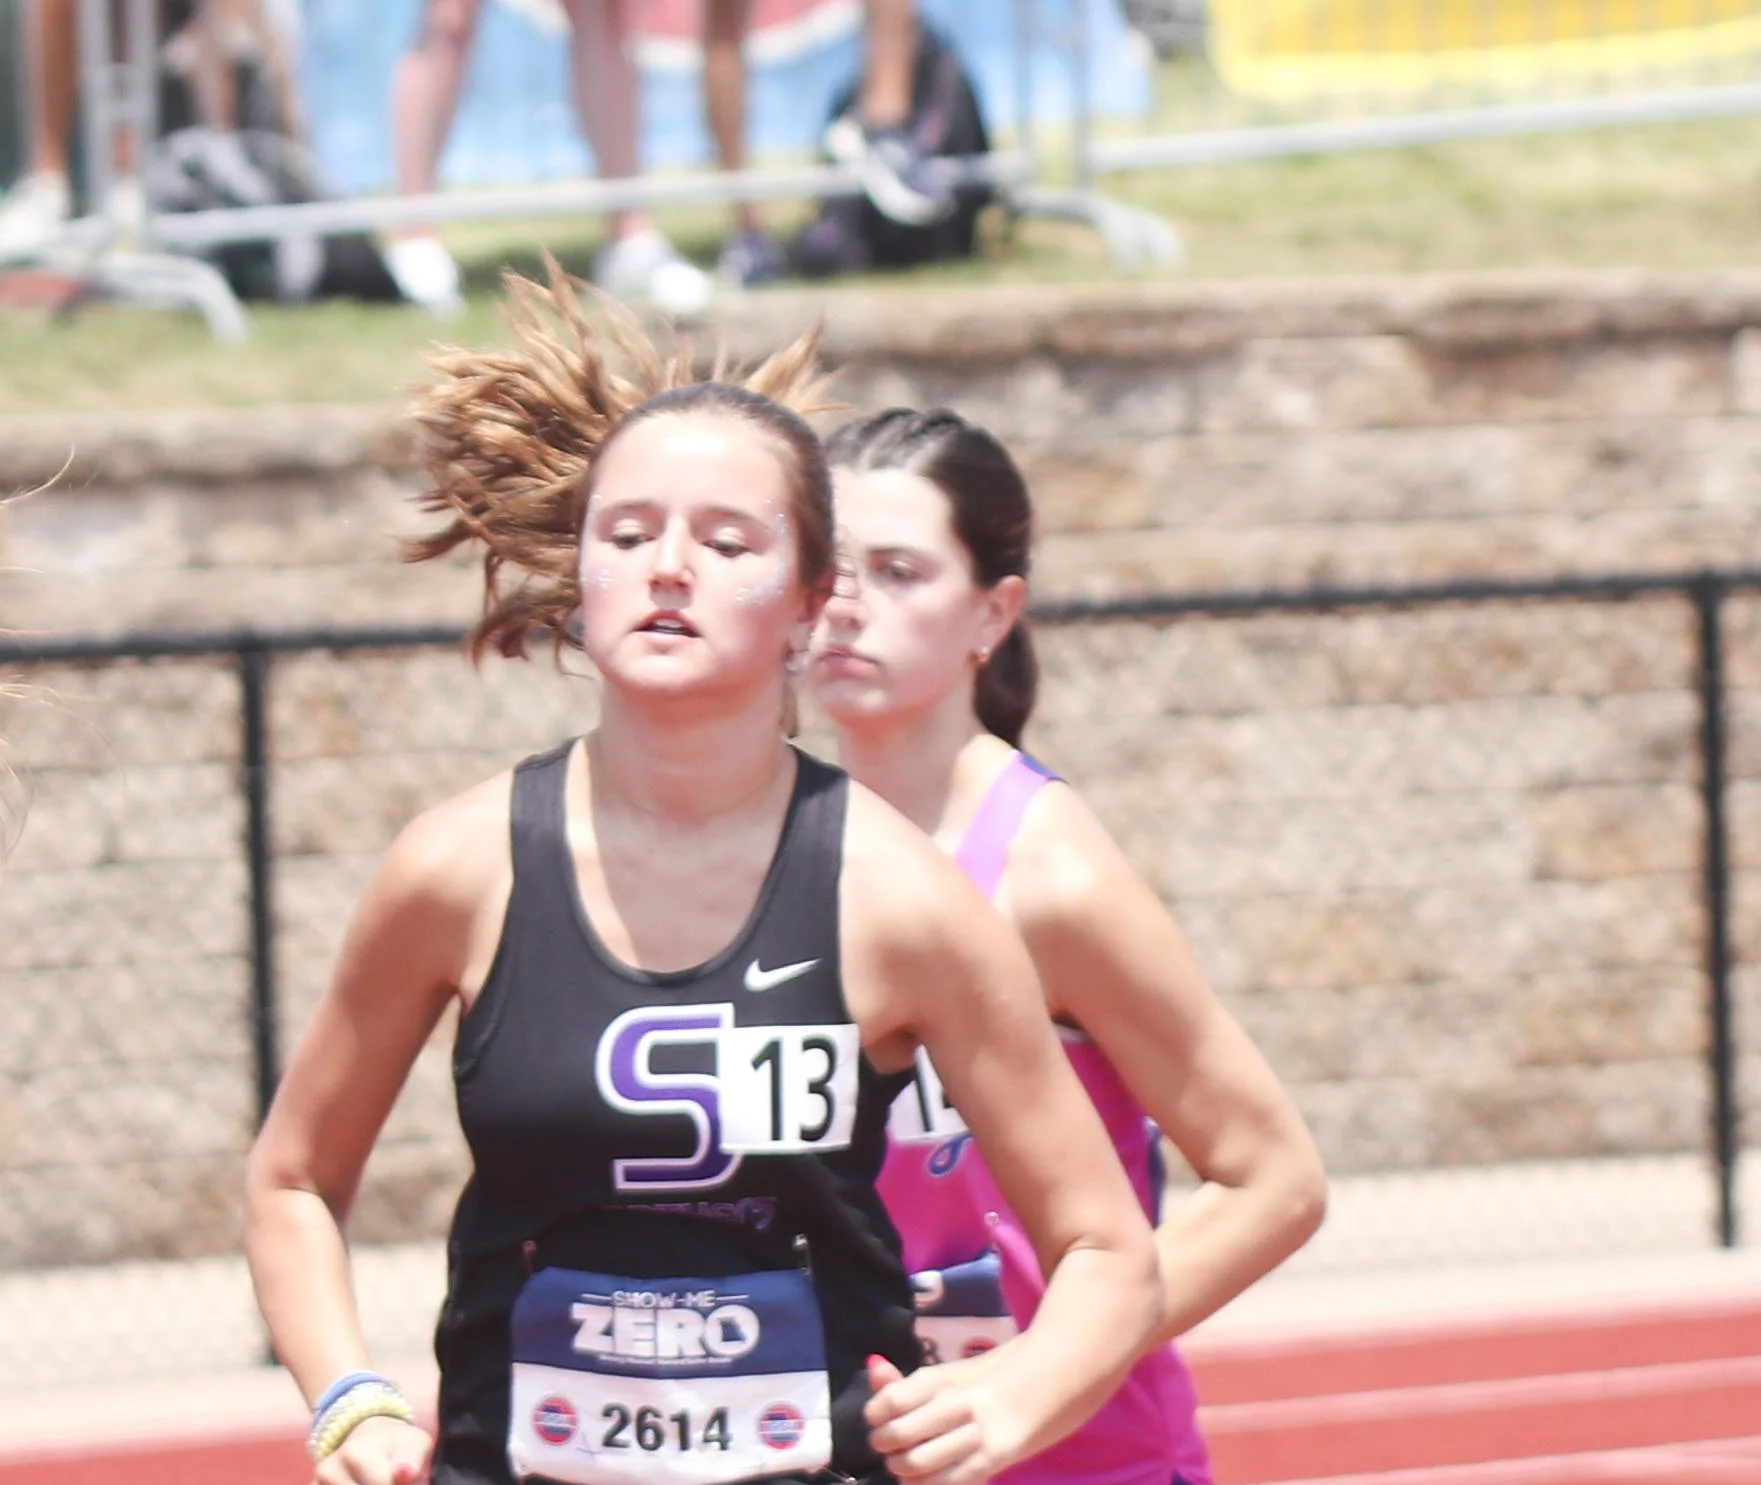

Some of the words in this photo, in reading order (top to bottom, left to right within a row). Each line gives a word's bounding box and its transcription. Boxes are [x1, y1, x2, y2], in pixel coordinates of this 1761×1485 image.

[594, 1002, 742, 1192] S
[750, 1034, 837, 1142] 13
[612, 1290, 717, 1308] SHOW-ME
[570, 1302, 760, 1357] ZERO
[601, 1402, 732, 1451] 2614
